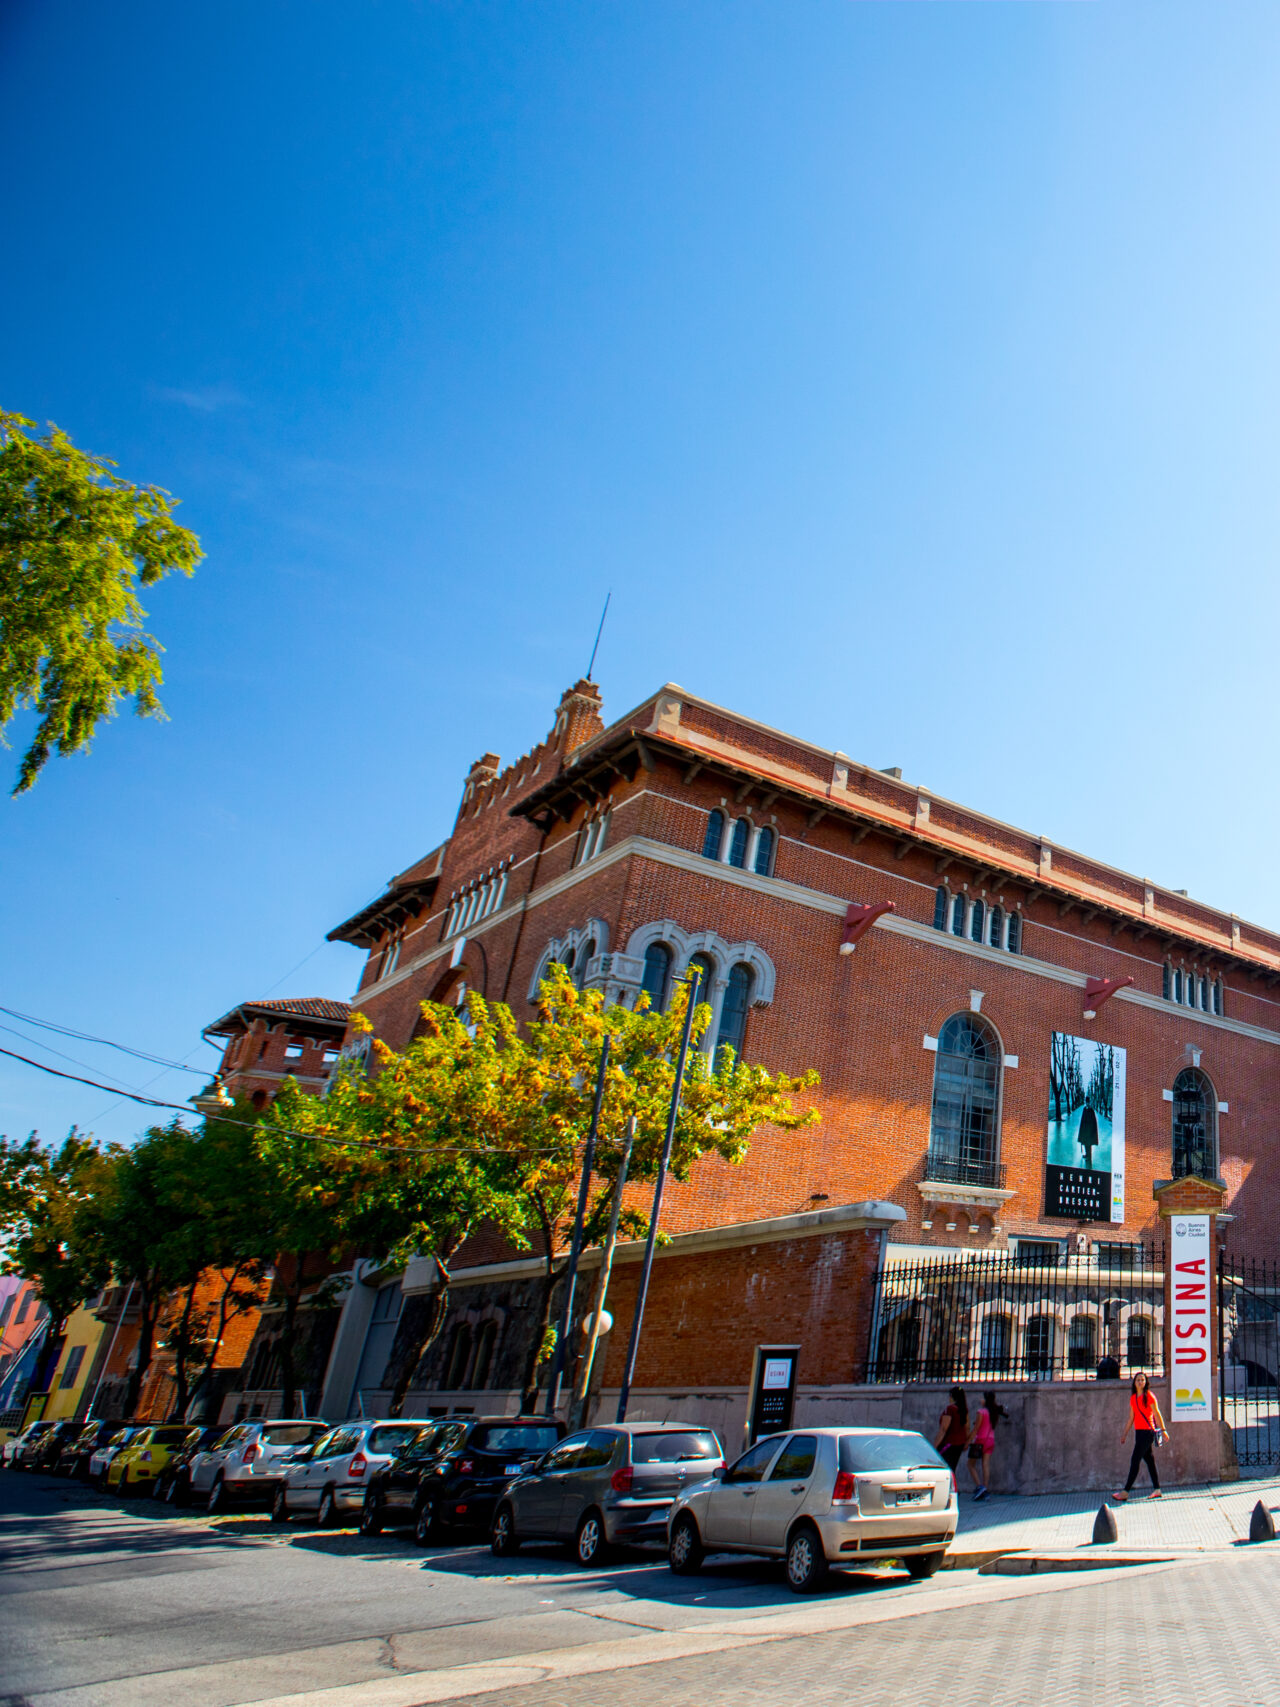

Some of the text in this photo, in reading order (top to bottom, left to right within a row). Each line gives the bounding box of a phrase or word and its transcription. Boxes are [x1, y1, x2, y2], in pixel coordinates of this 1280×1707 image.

[1060, 1172, 1100, 1185] HENRI
[1059, 1184, 1100, 1196] CARTIER-
[1059, 1196, 1100, 1208] BRESSON
[1175, 1259, 1206, 1364] USINA
